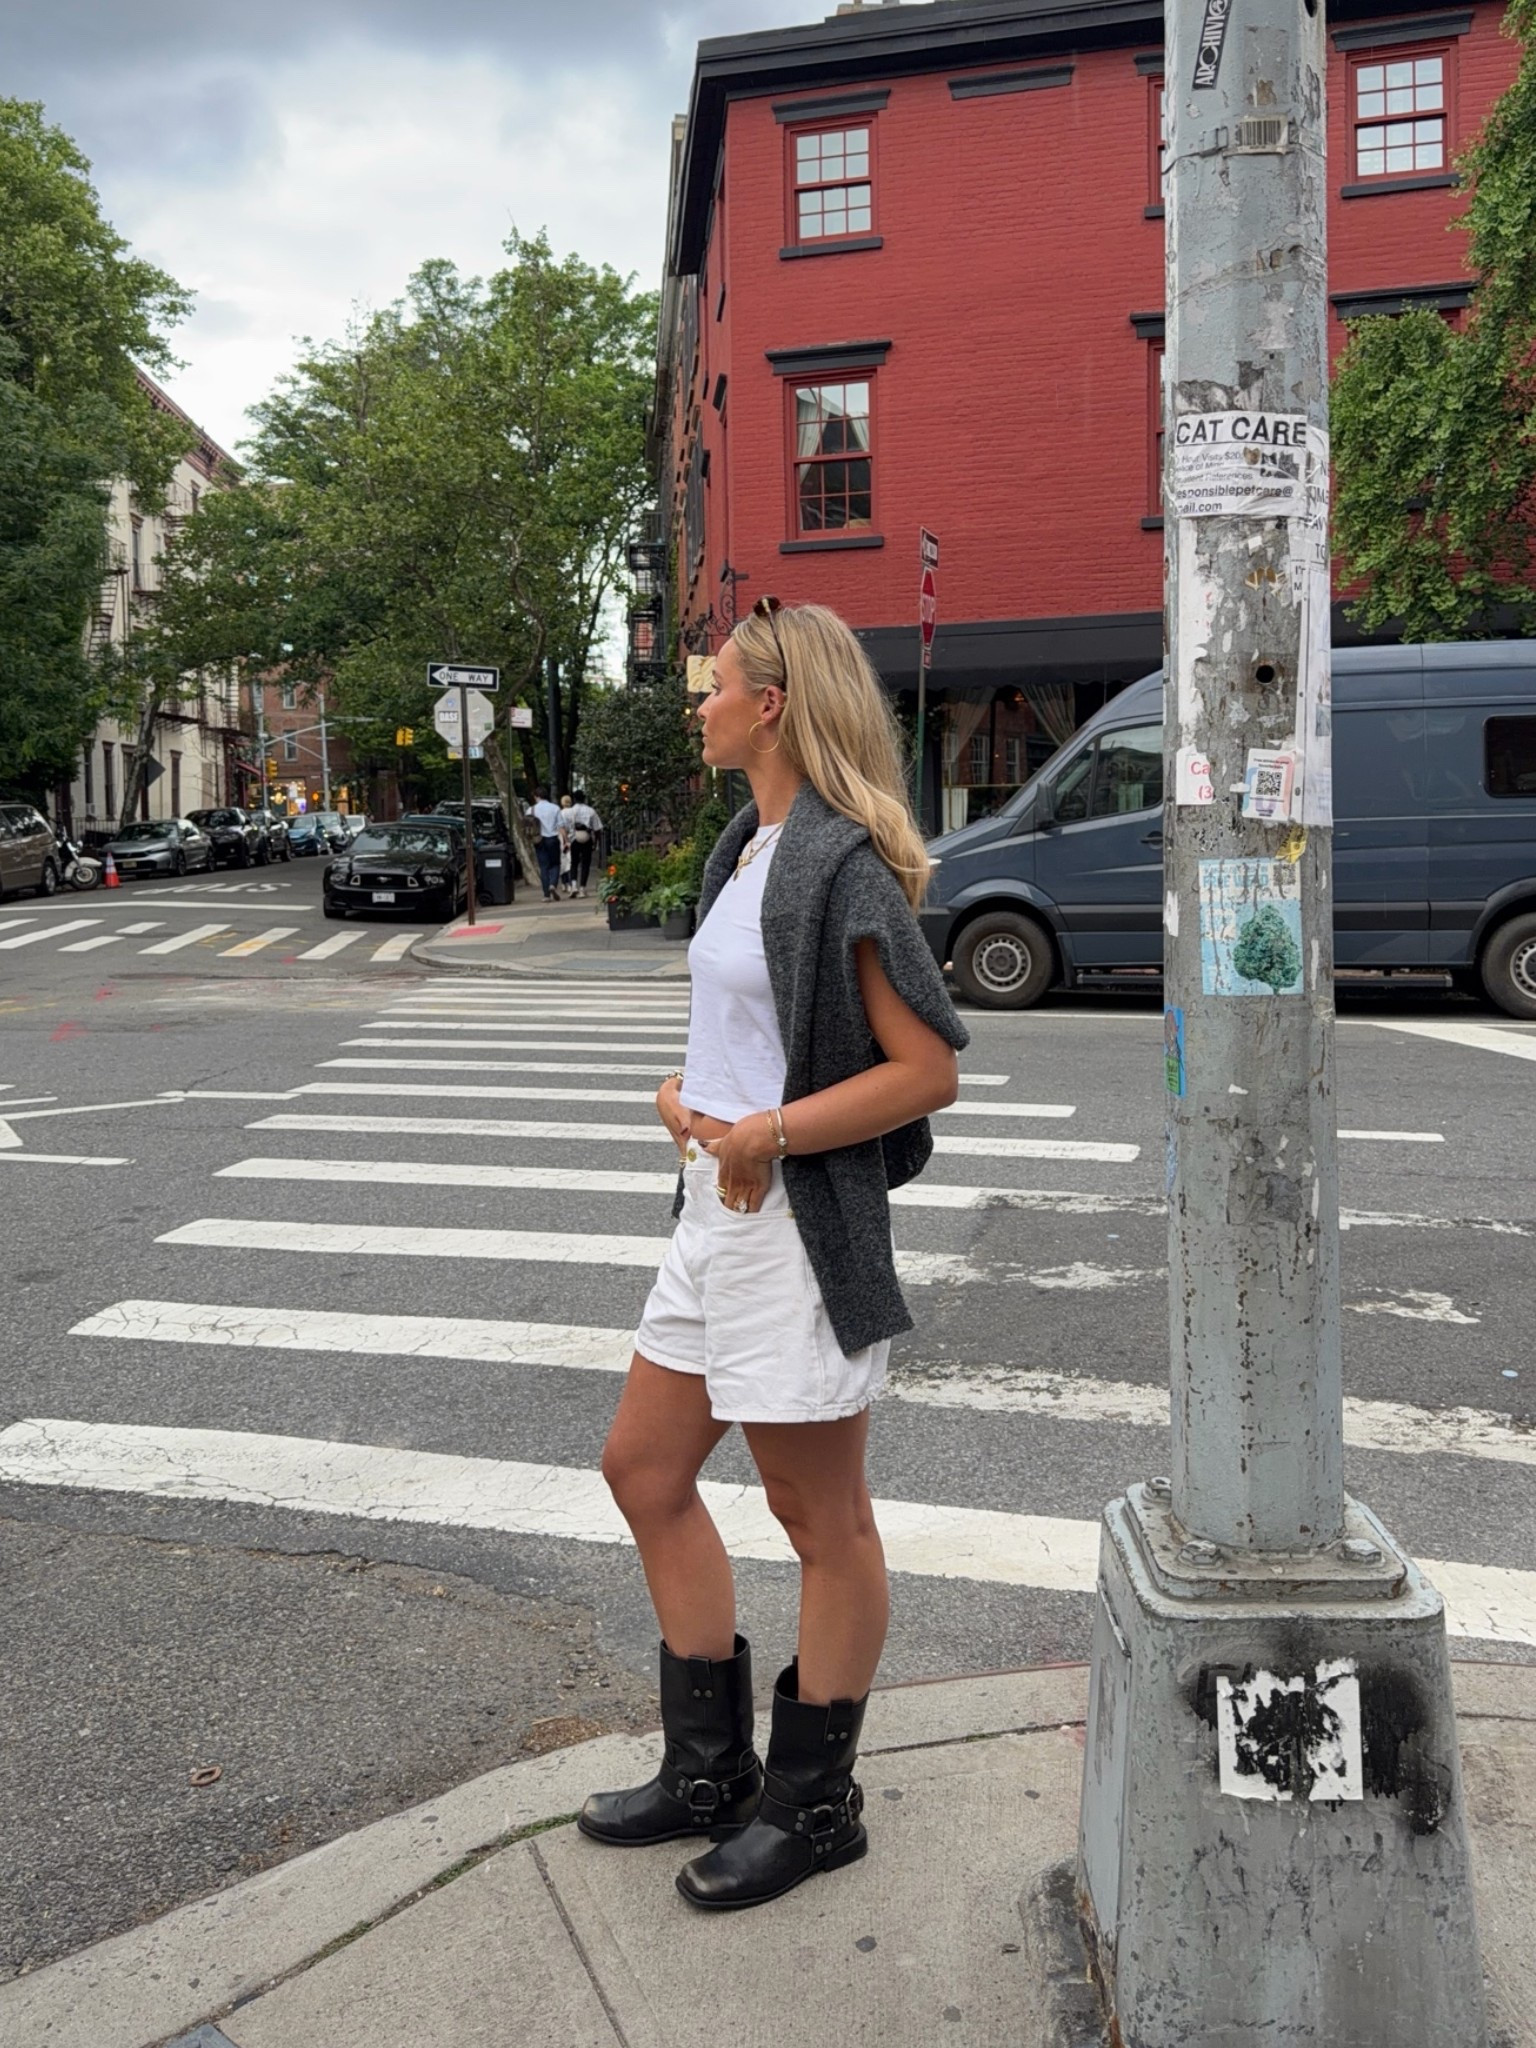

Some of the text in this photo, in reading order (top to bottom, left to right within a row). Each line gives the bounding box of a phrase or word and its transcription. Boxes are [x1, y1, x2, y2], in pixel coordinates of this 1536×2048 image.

[1176, 416, 1307, 445] CAT CARE
[1176, 484, 1294, 500] esponsiblepetcare@
[439, 671, 489, 683] ONE WAY
[1203, 875, 1231, 888] FRE
